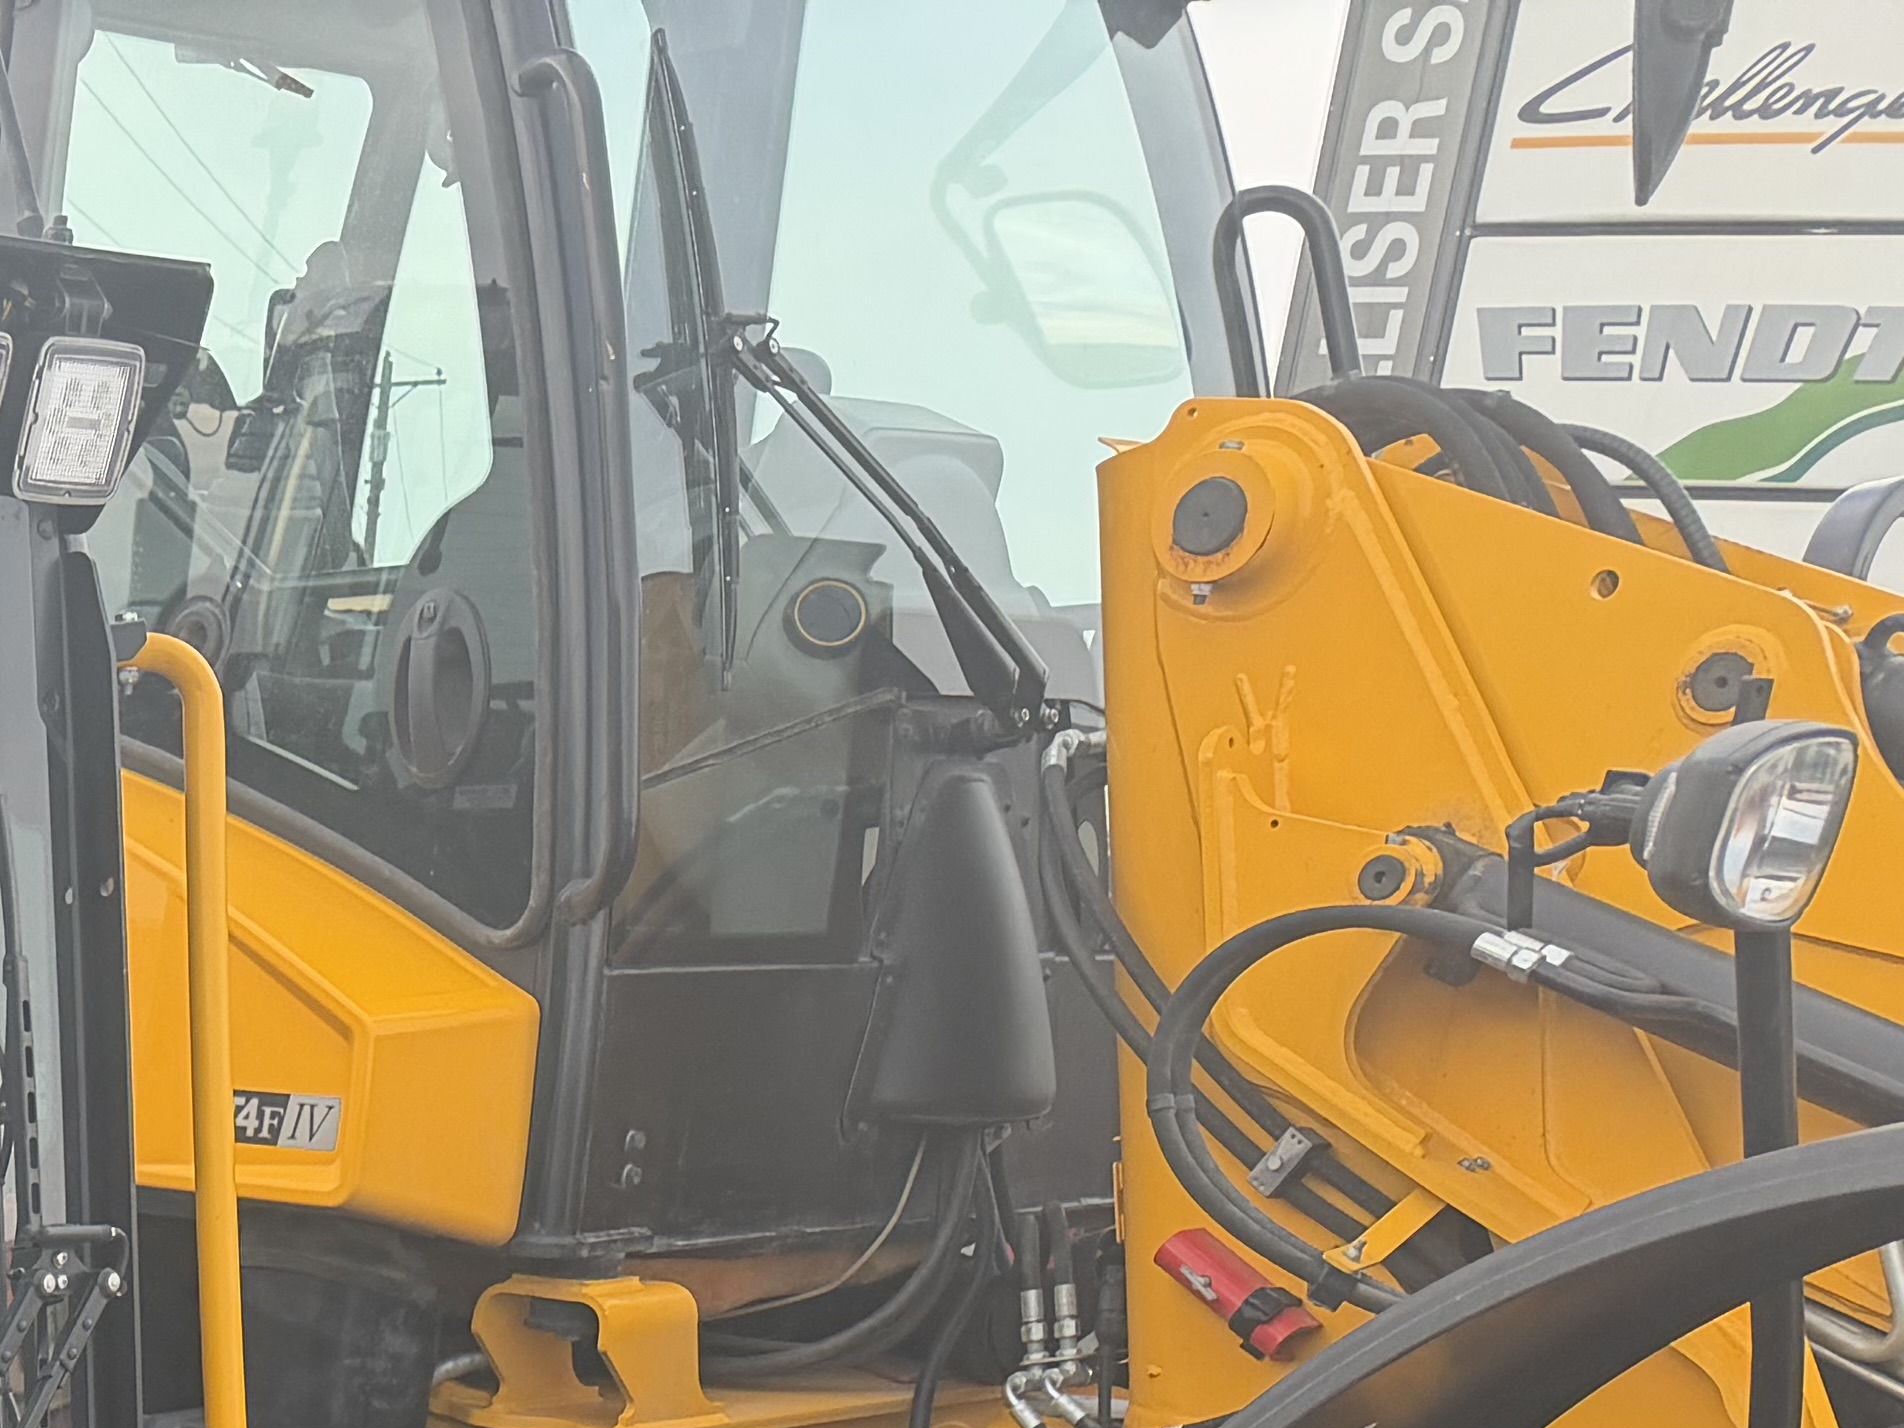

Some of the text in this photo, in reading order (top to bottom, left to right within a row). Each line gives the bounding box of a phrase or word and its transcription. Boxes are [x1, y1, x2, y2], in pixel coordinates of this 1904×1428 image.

[1382, 0, 1469, 64] S
[1476, 303, 1904, 383] FENDT
[287, 1103, 335, 1142] IV
